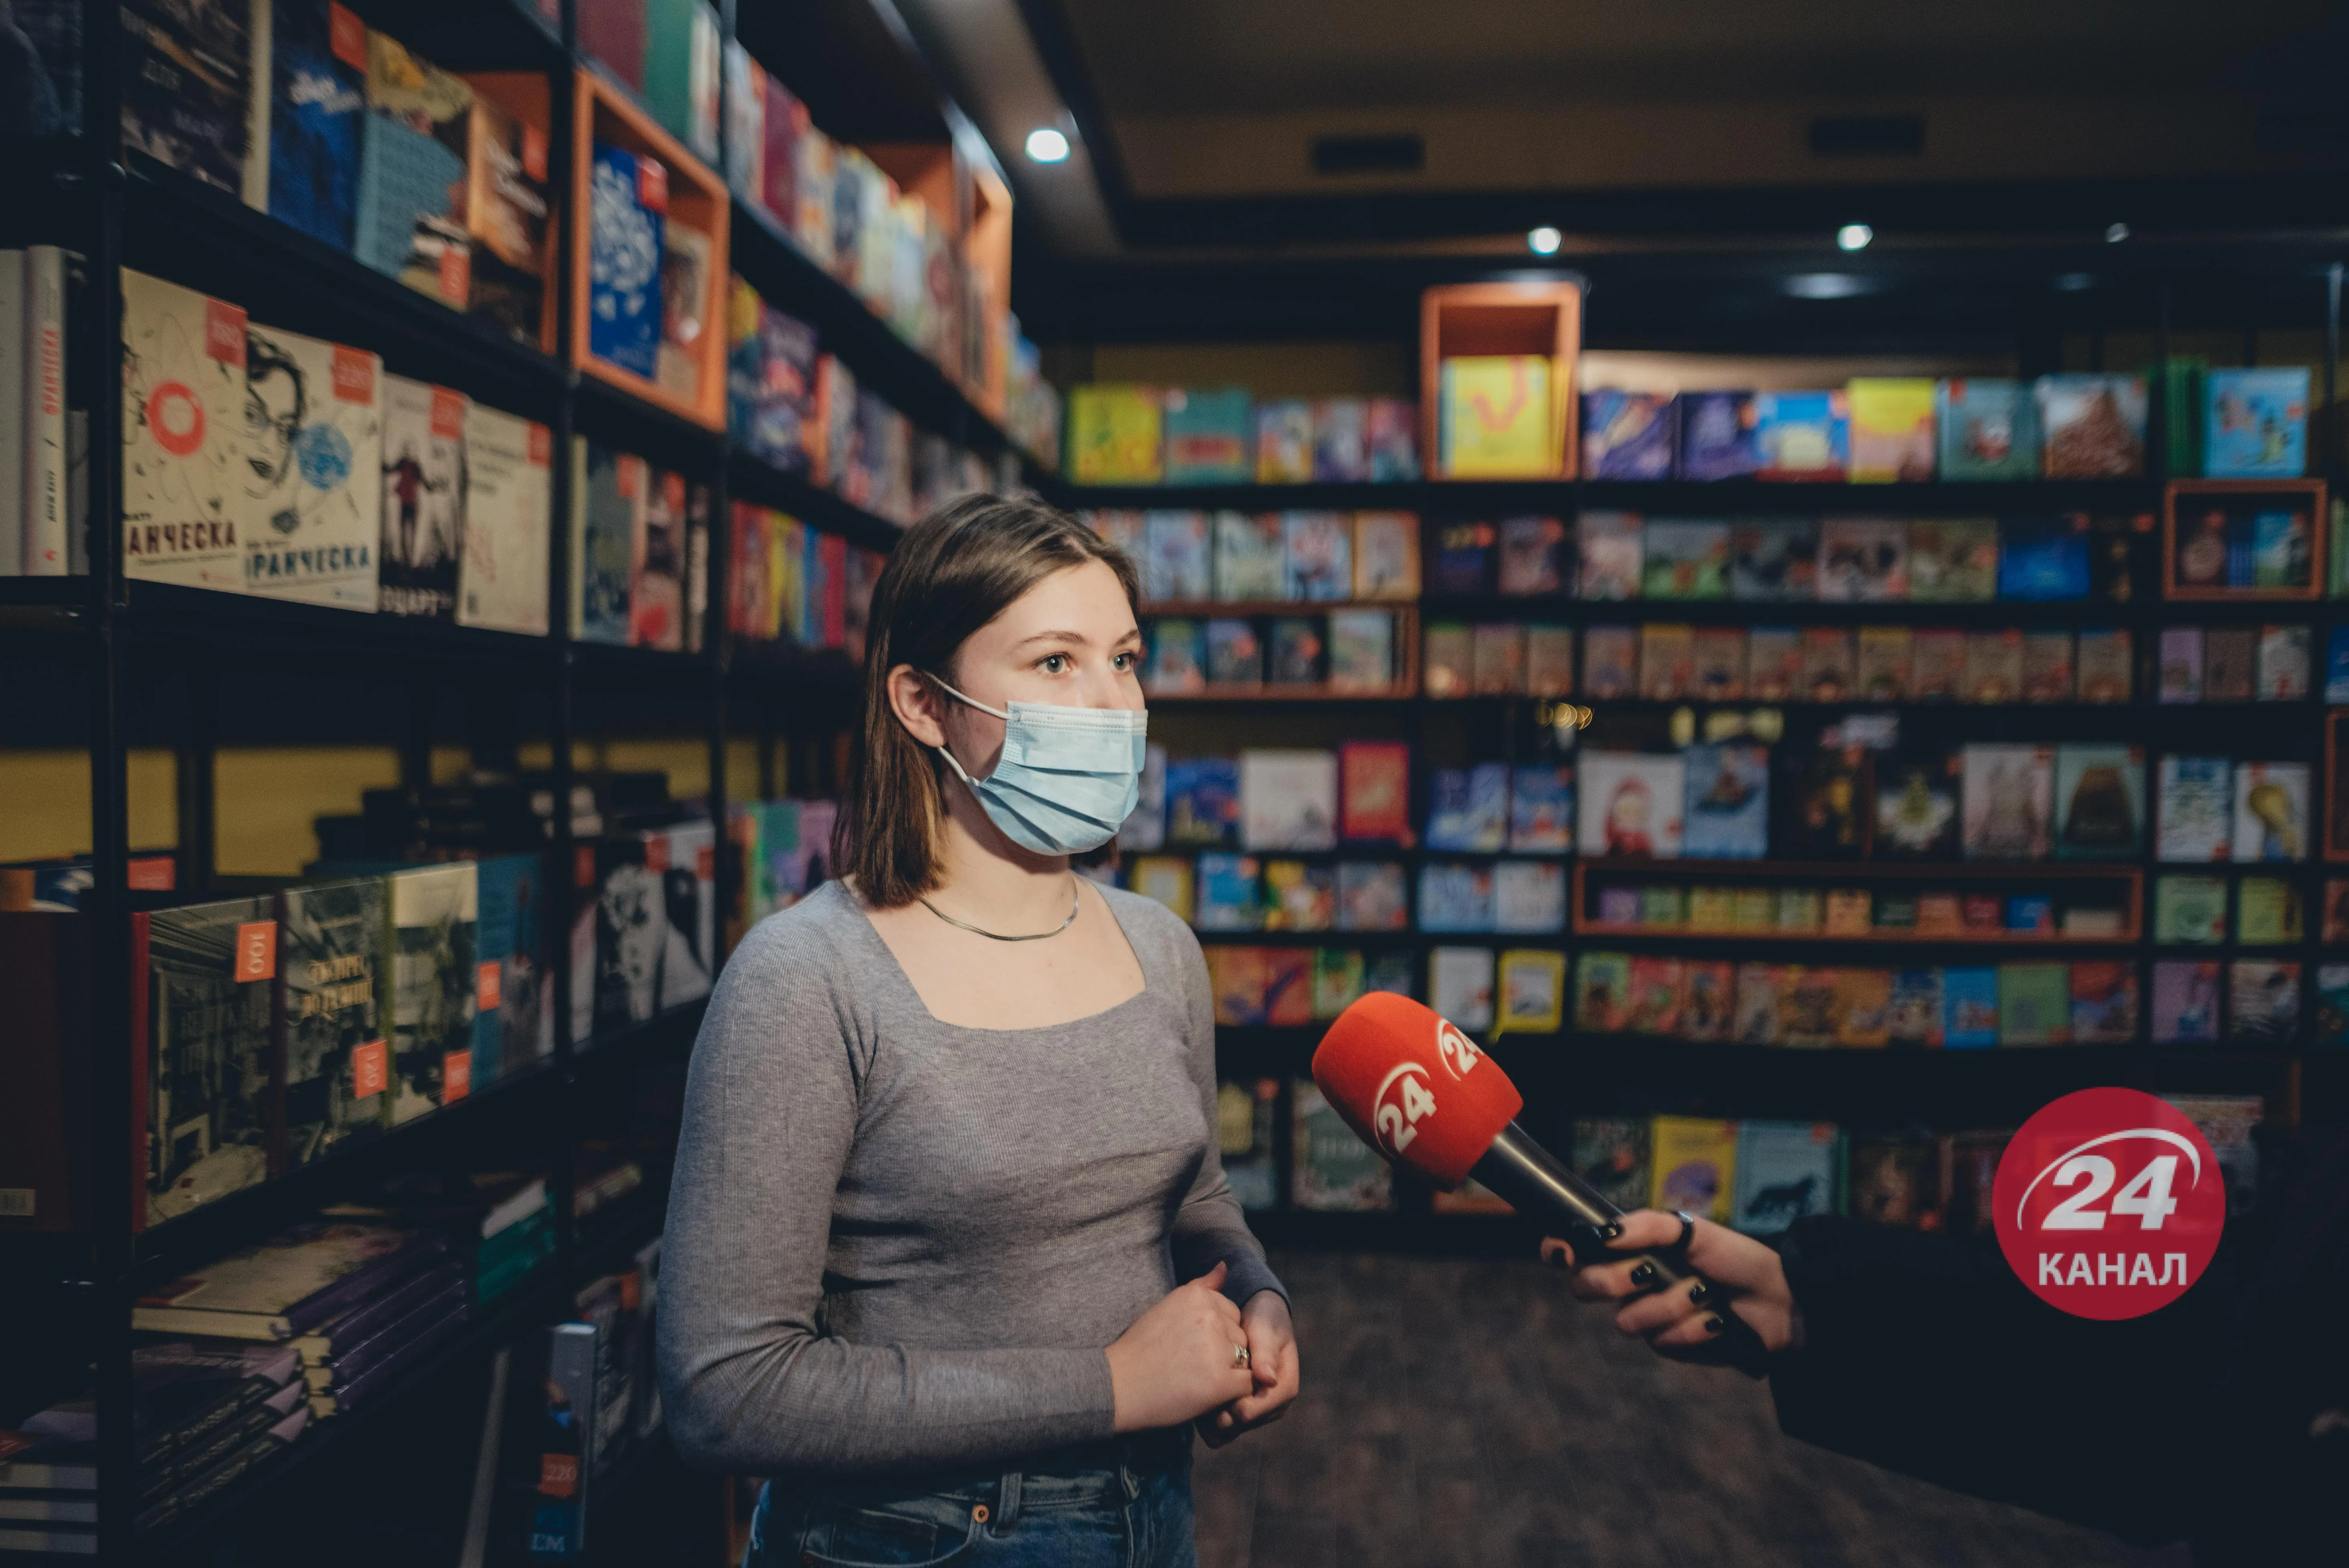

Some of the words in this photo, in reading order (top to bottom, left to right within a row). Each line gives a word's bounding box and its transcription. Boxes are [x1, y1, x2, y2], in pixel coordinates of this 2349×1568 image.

[248, 933, 266, 975] 100
[1378, 1075, 1437, 1154] 24
[546, 1464, 578, 1482] 220
